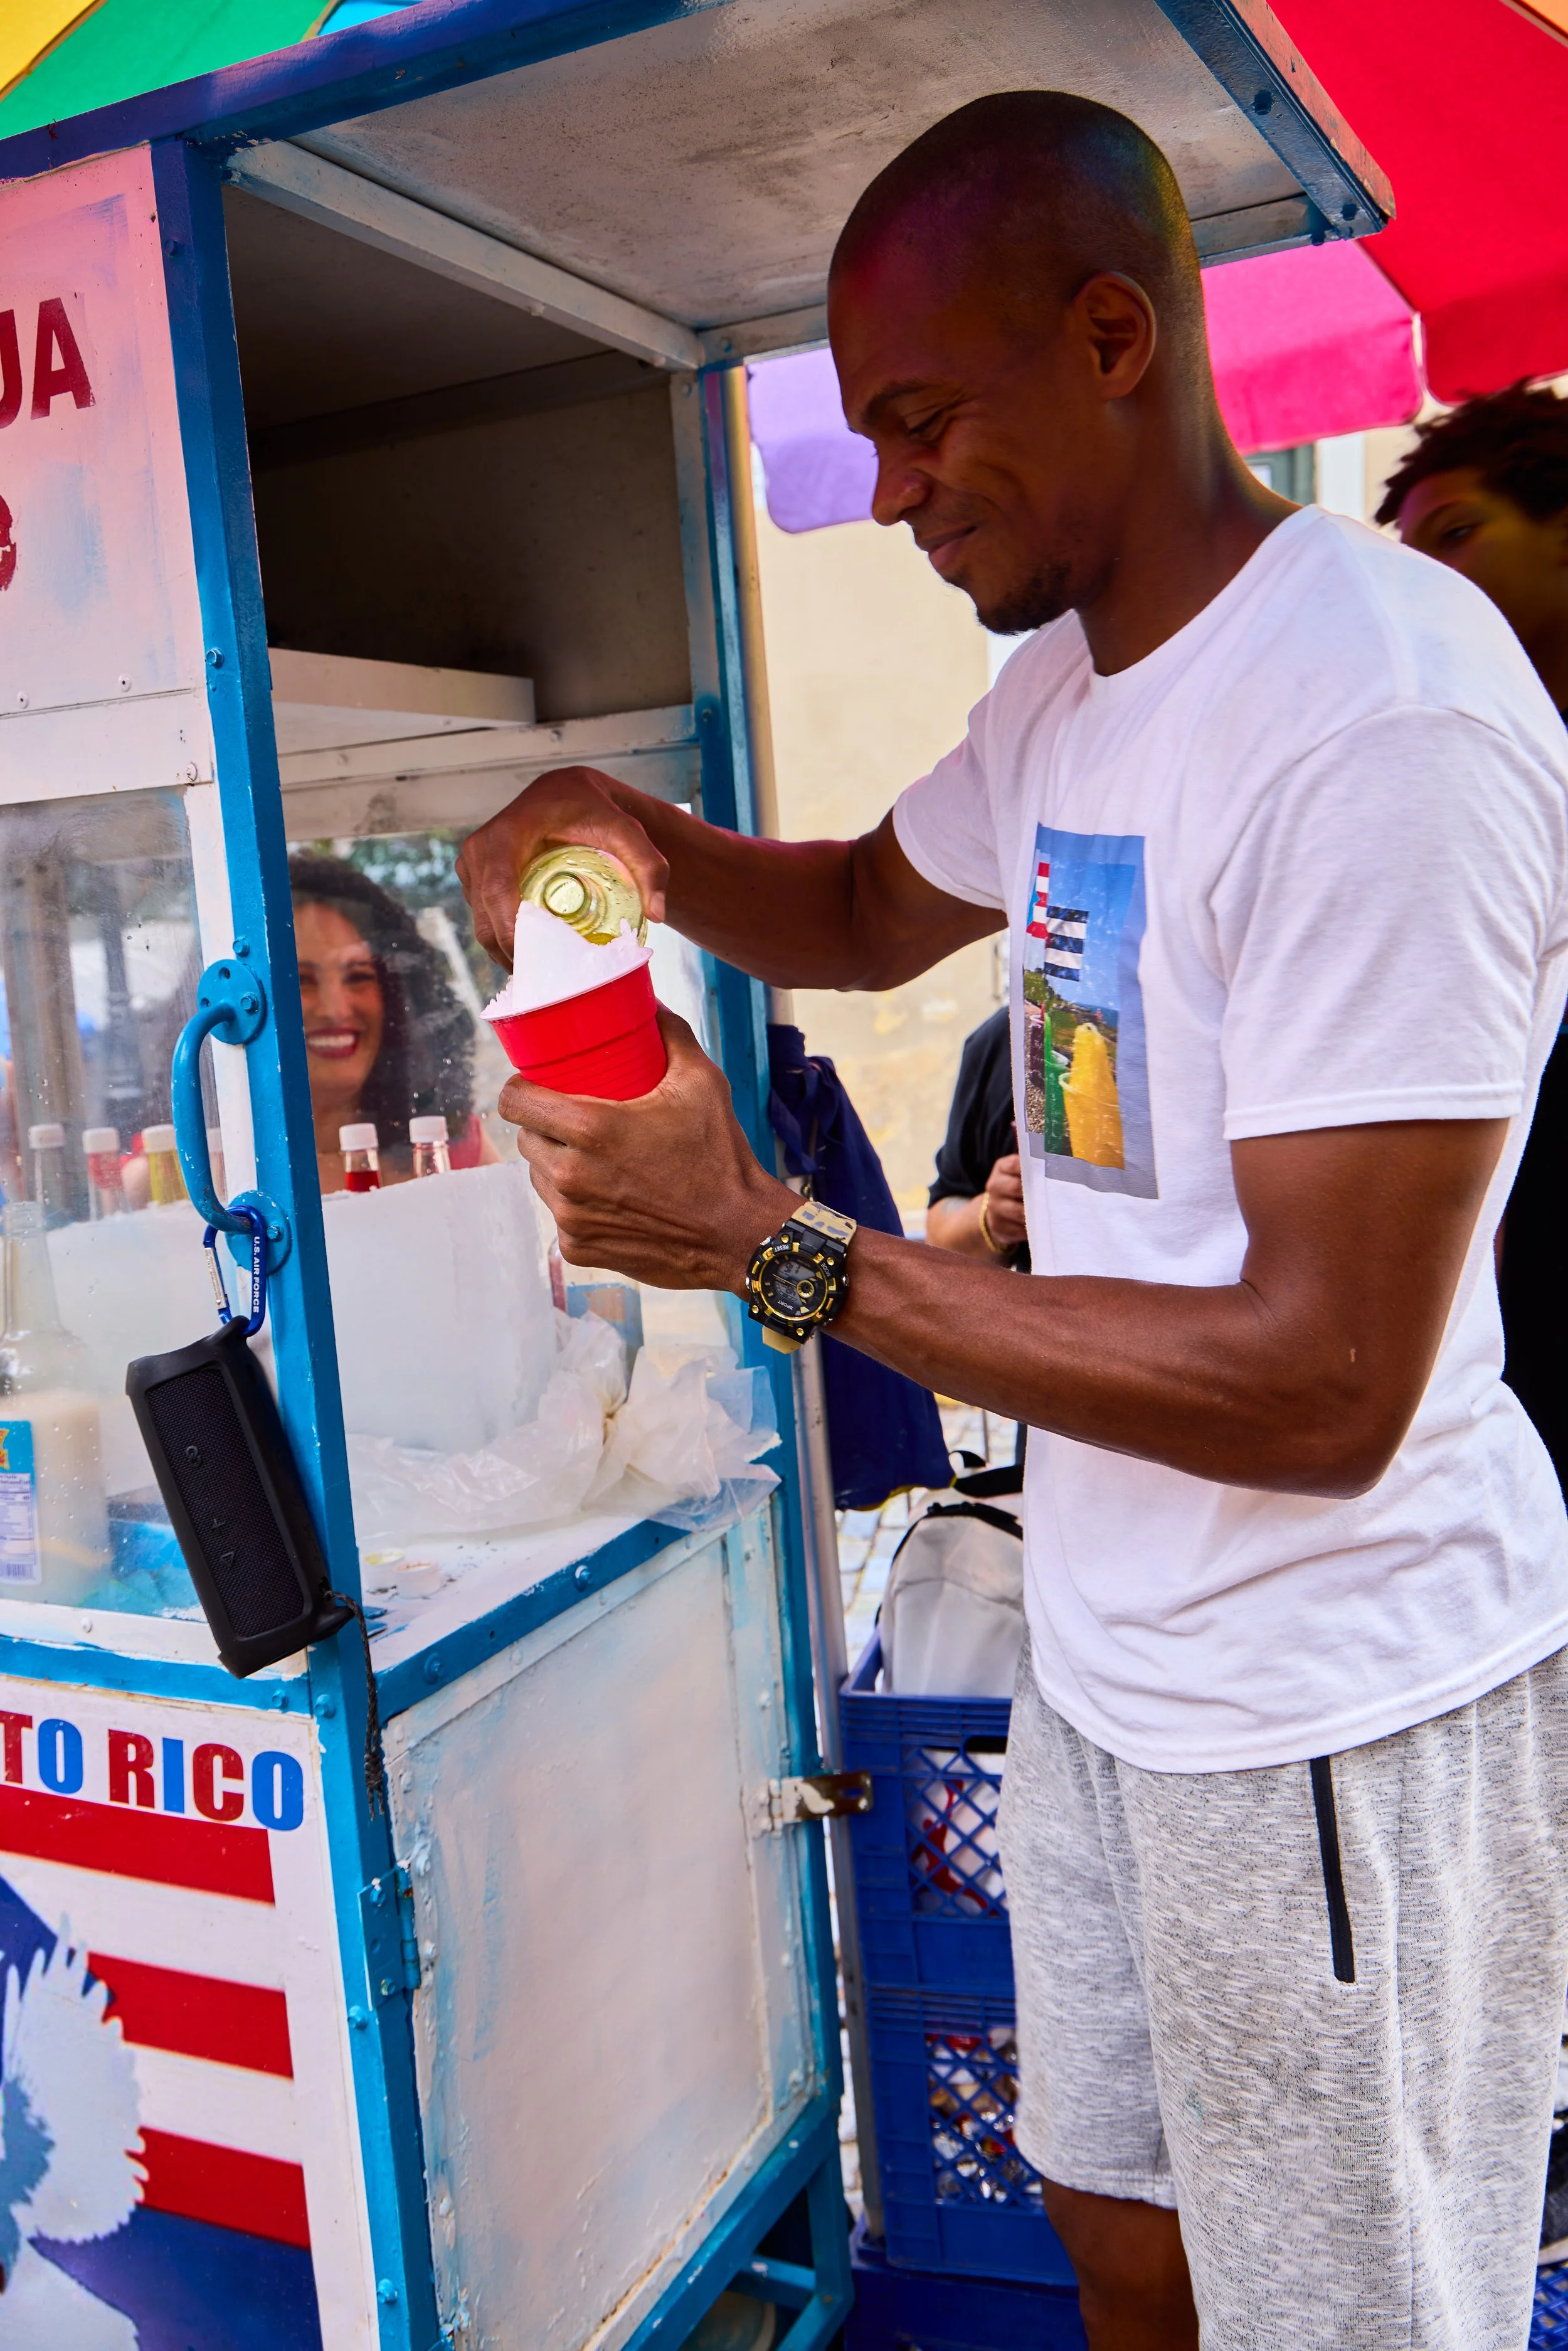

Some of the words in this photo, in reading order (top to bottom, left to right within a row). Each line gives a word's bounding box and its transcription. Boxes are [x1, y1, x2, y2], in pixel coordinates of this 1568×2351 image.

[774, 1244, 789, 1253] RESET
[778, 1299, 793, 1310] SPORT
[108, 1728, 304, 1832] RICO
